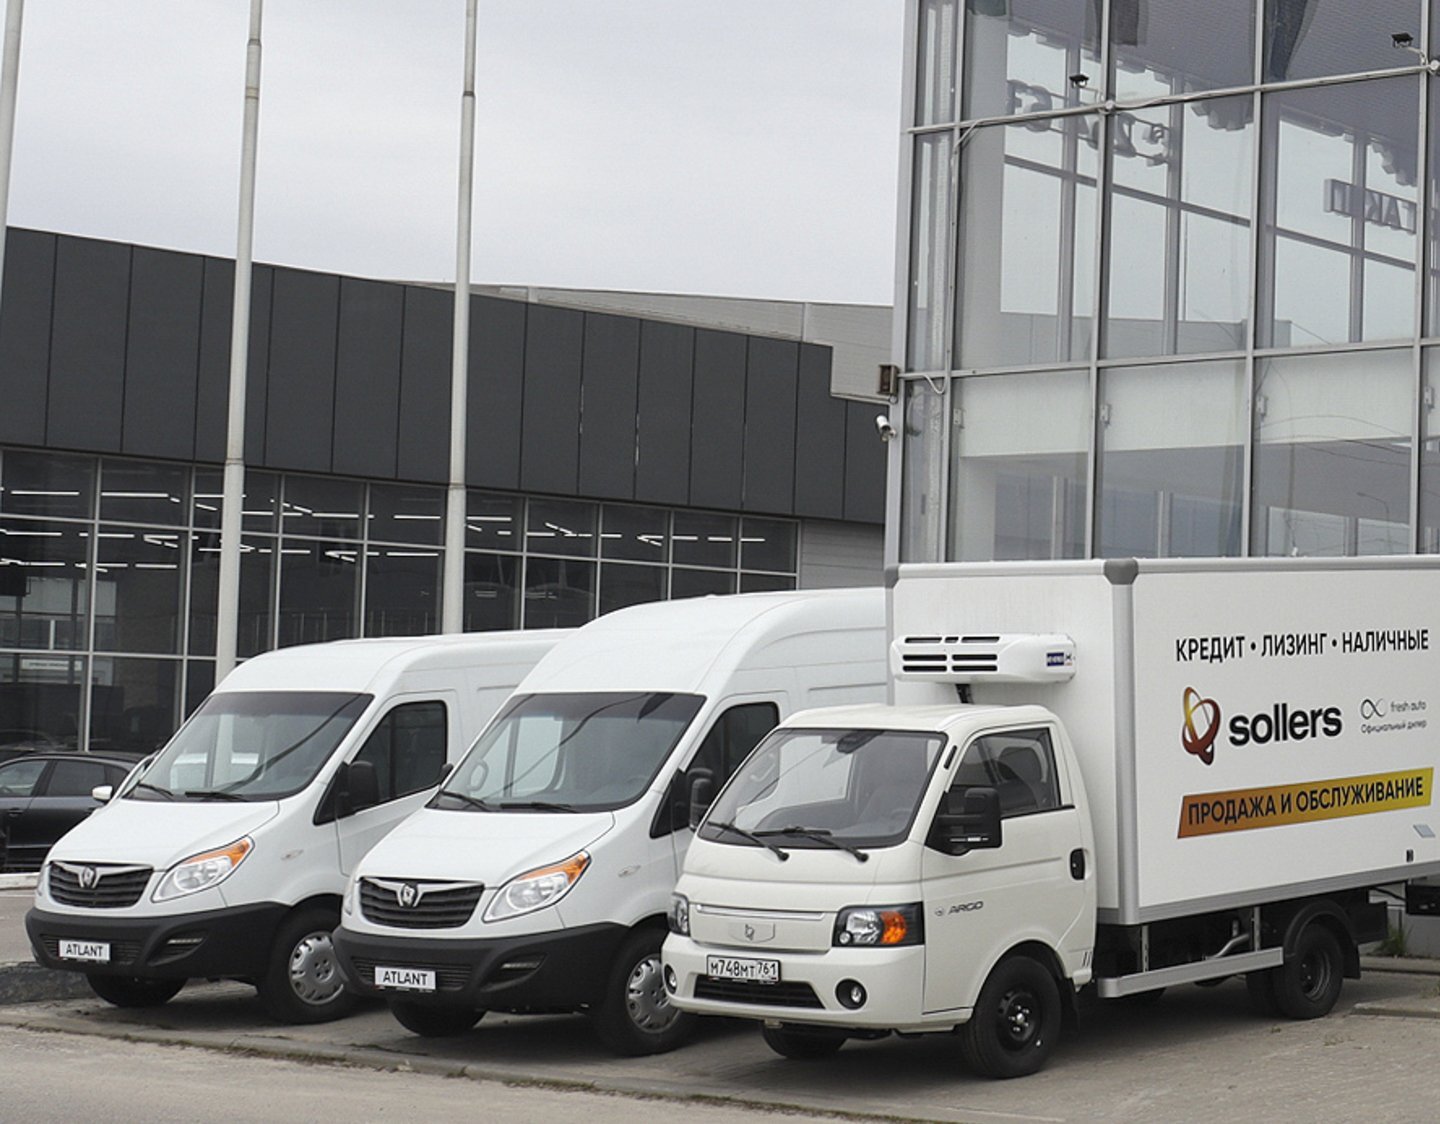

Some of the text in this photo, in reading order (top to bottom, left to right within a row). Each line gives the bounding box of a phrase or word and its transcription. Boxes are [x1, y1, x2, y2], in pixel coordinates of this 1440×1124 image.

[1176, 629, 1429, 663] КРЕДИТ ЛИЗИНГ НАЛИЧНЫЕ
[1229, 703, 1342, 746] sollers
[1188, 776, 1424, 825] ПРОДАЖА И ОБСЛУЖИВАНИЕ
[66, 943, 103, 957] ATLANT
[383, 970, 428, 986] ATLANT
[758, 962, 776, 976] 761
